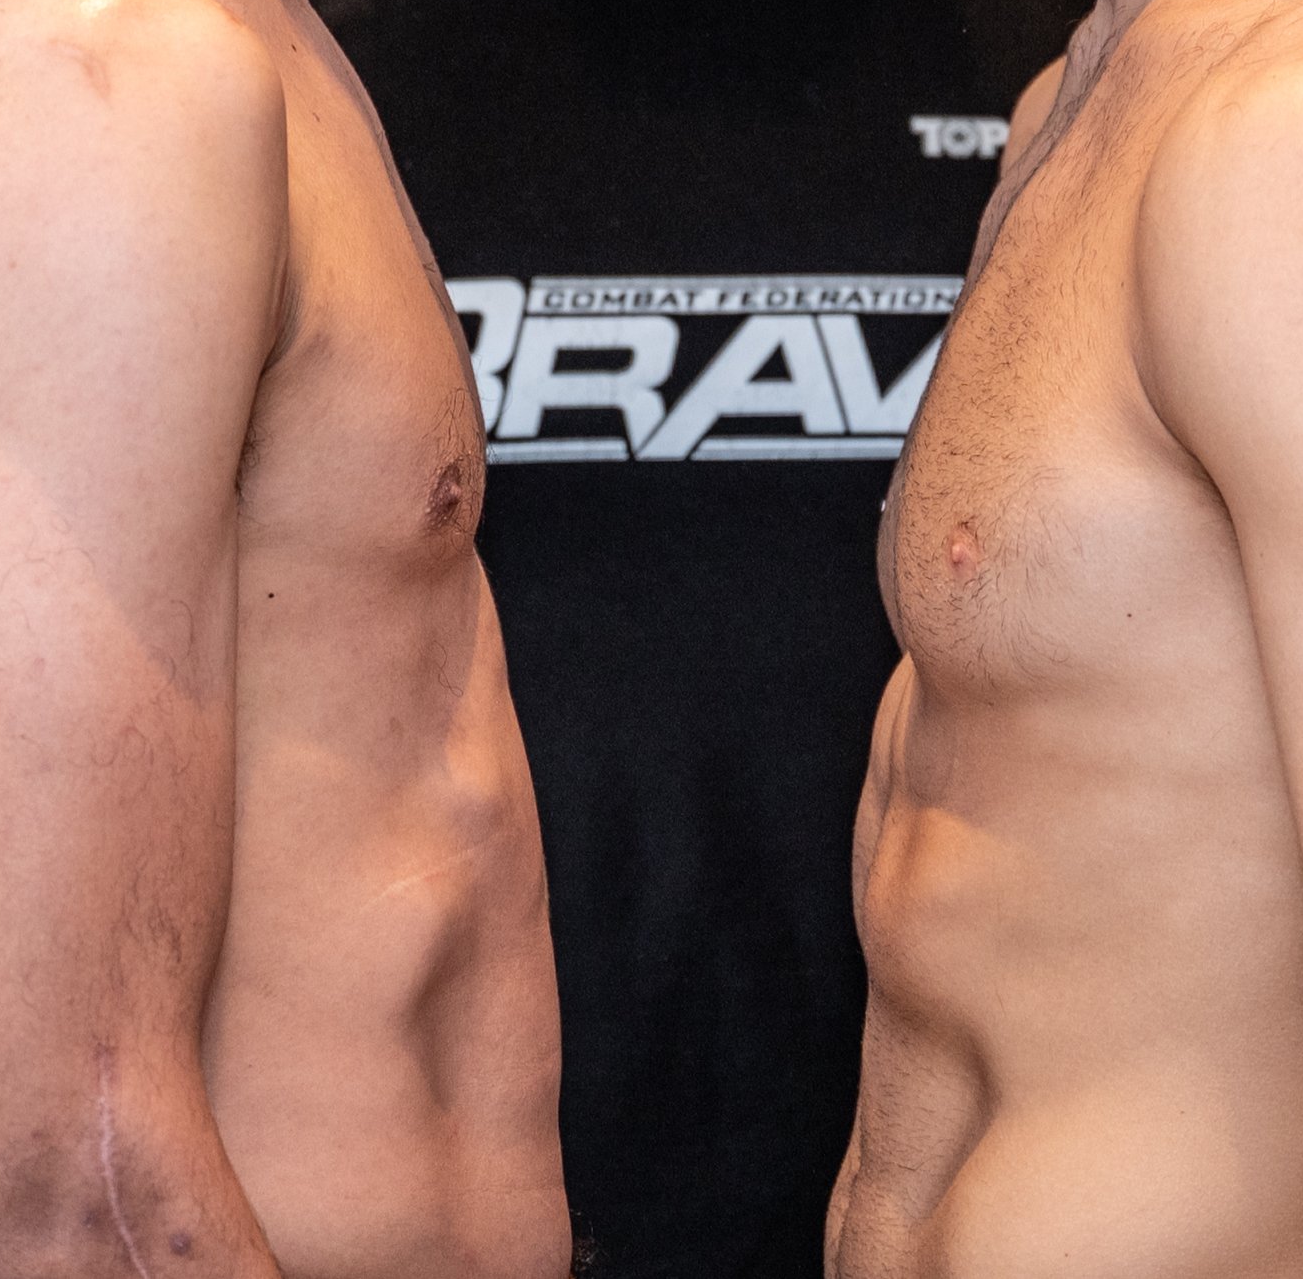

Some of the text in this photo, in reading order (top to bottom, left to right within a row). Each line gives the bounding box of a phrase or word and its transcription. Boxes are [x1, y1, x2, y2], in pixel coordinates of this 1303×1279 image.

[909, 114, 1009, 159] TOP
[543, 286, 959, 312] COMBAT FEDERATION
